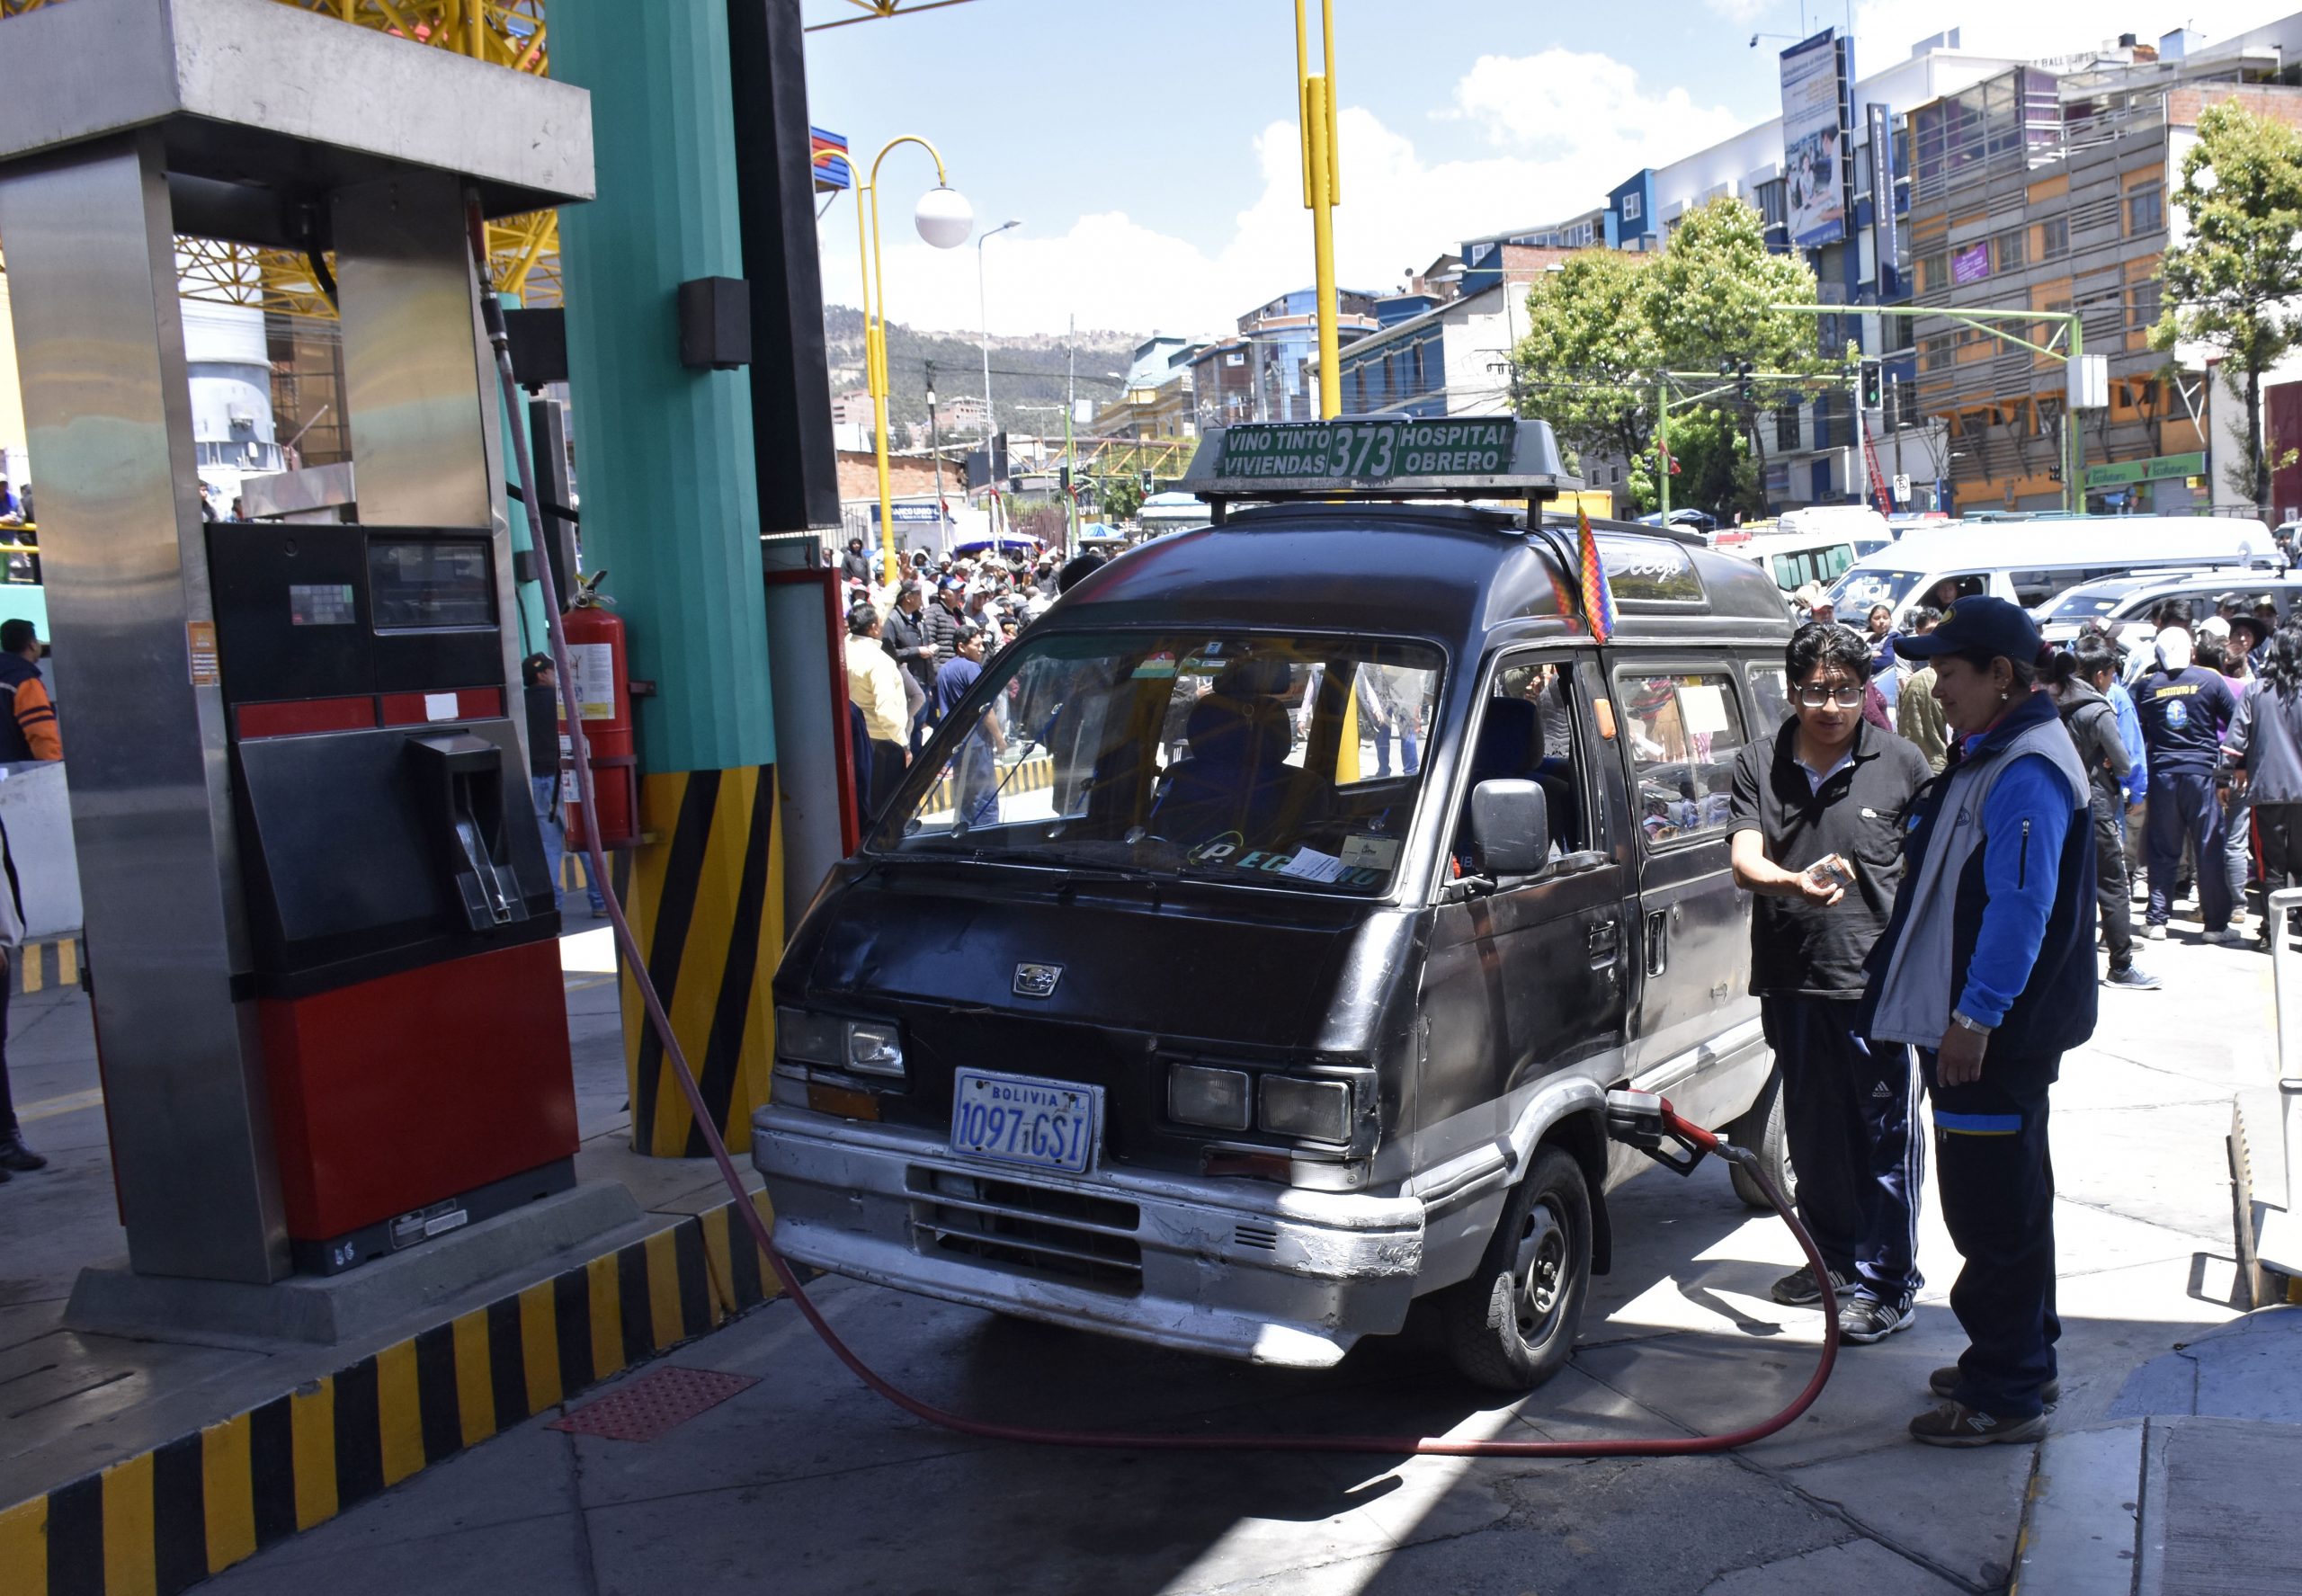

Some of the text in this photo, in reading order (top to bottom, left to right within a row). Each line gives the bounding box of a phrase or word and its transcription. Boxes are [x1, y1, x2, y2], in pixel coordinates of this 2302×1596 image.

[1229, 428, 1331, 450] VINO TINTO
[1400, 425, 1510, 447] HOSPITAL
[1329, 426, 1396, 477] 373
[1405, 450, 1499, 473] OBRERO
[1224, 455, 1326, 477] VIVIENDAS
[992, 1086, 1058, 1107] BOLIVIA
